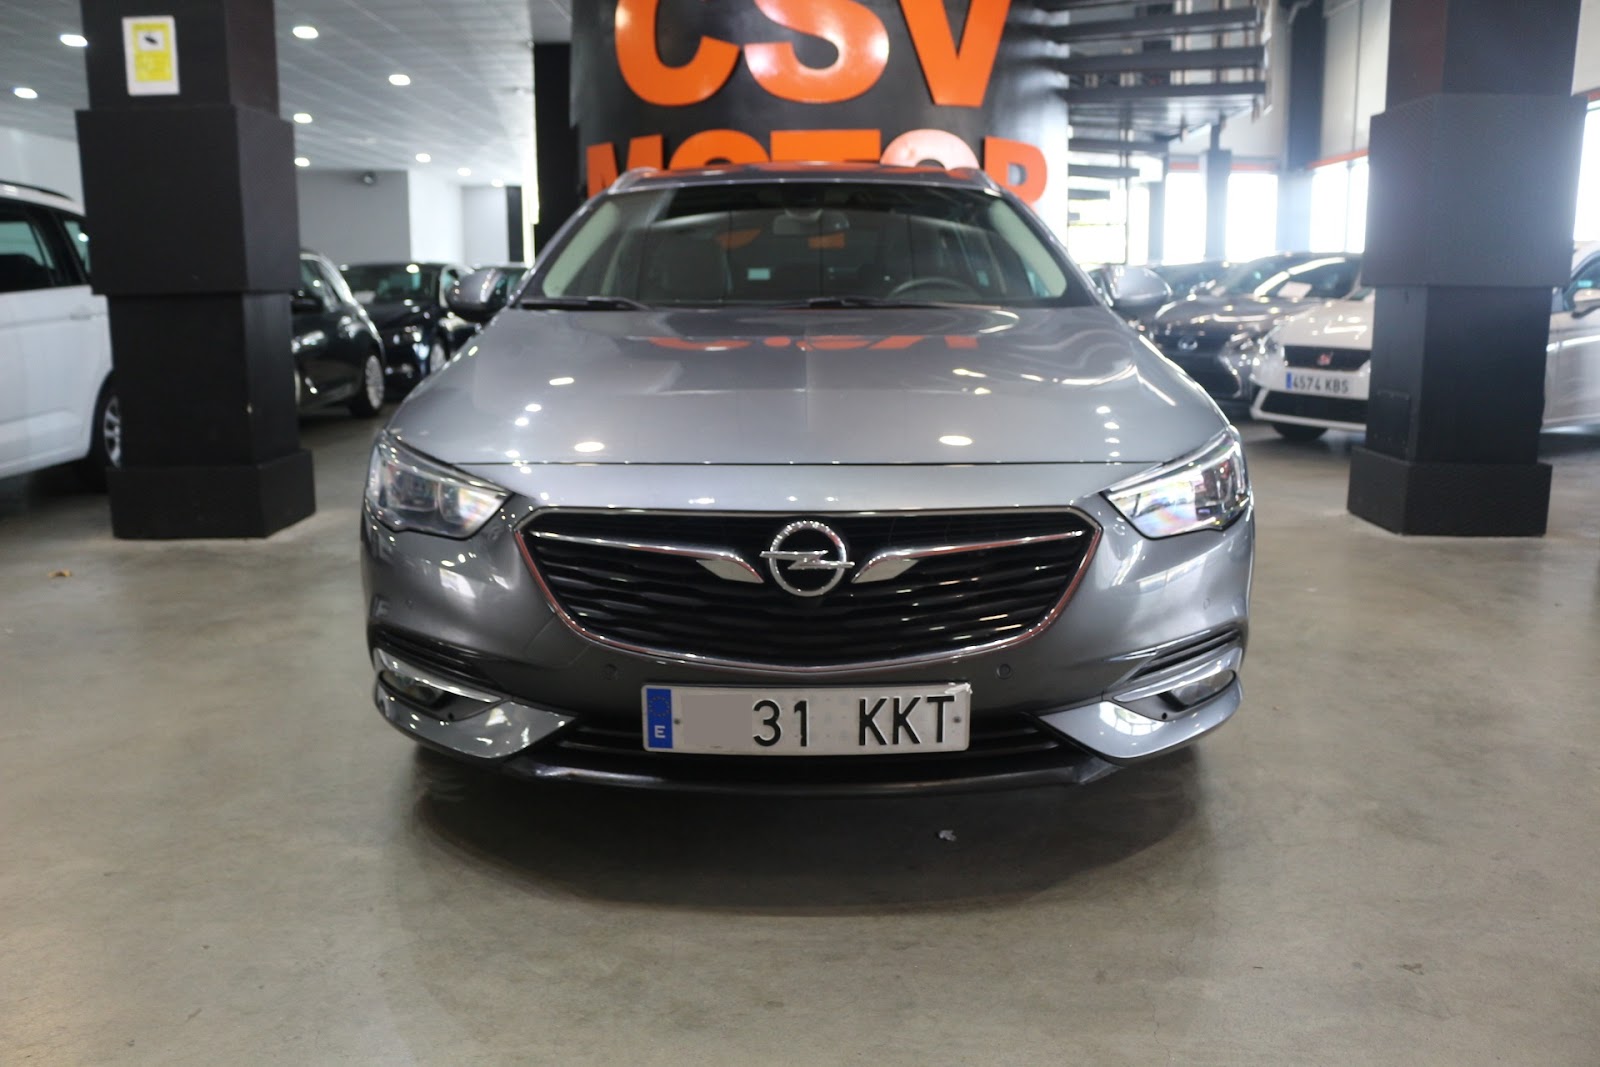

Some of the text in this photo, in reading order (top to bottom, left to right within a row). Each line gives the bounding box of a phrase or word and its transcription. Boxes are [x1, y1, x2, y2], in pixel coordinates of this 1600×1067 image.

[615, 0, 1010, 107] CSV
[654, 725, 666, 738] E
[859, 696, 955, 746] KKT
